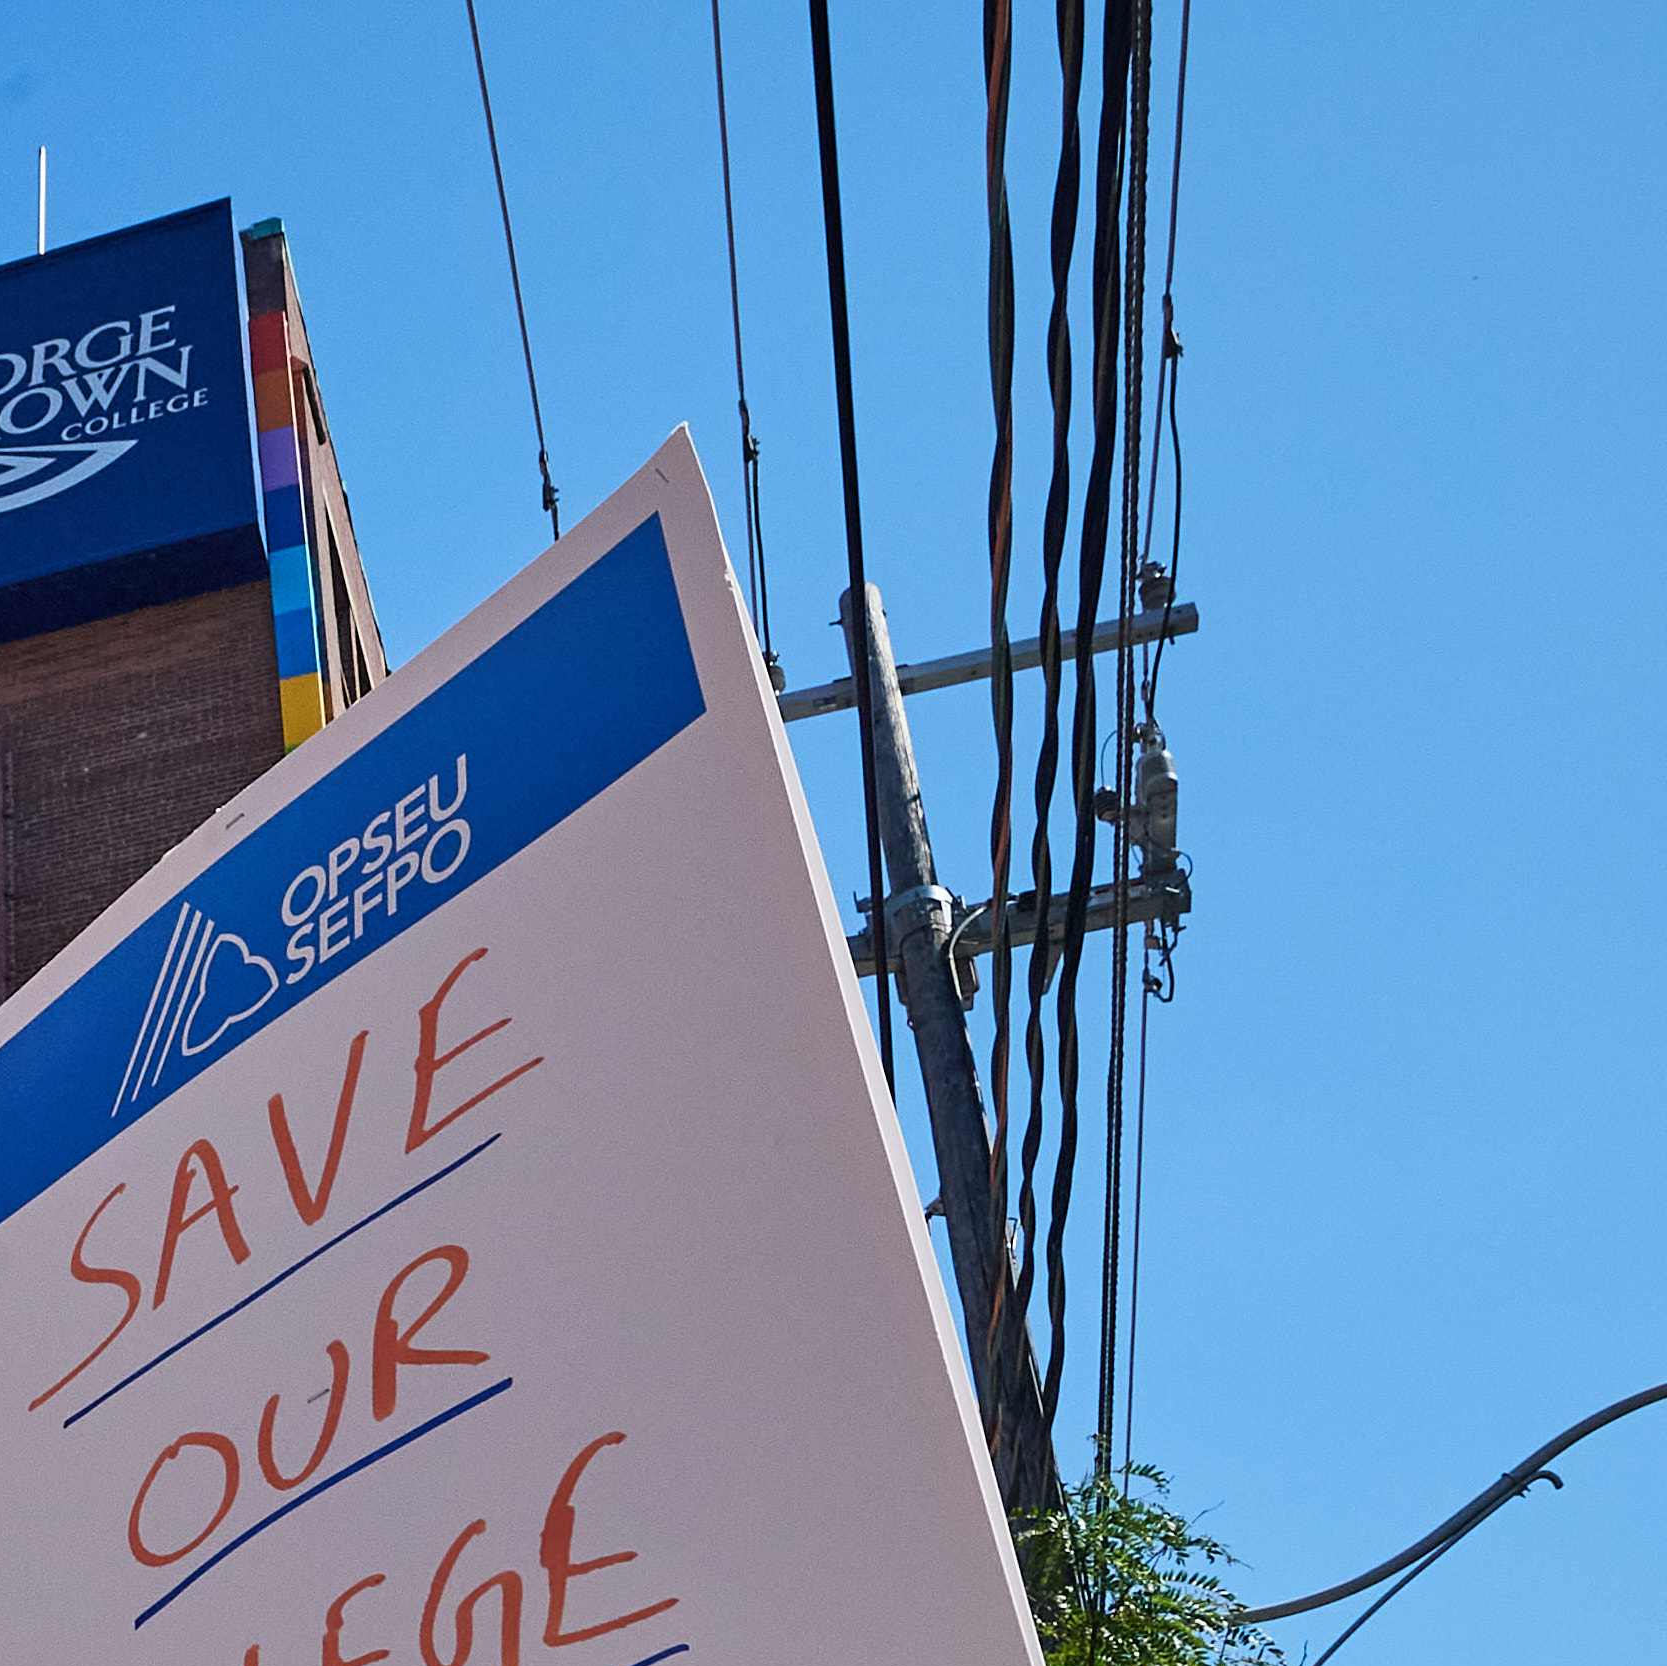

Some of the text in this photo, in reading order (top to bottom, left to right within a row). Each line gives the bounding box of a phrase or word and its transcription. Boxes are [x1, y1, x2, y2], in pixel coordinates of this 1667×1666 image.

[61, 387, 208, 442] COLLEGE
[281, 753, 467, 927] OPSEU
[286, 818, 471, 985] SEFPO
[29, 947, 544, 1412] SAVE
[128, 1244, 490, 1568] OUR
